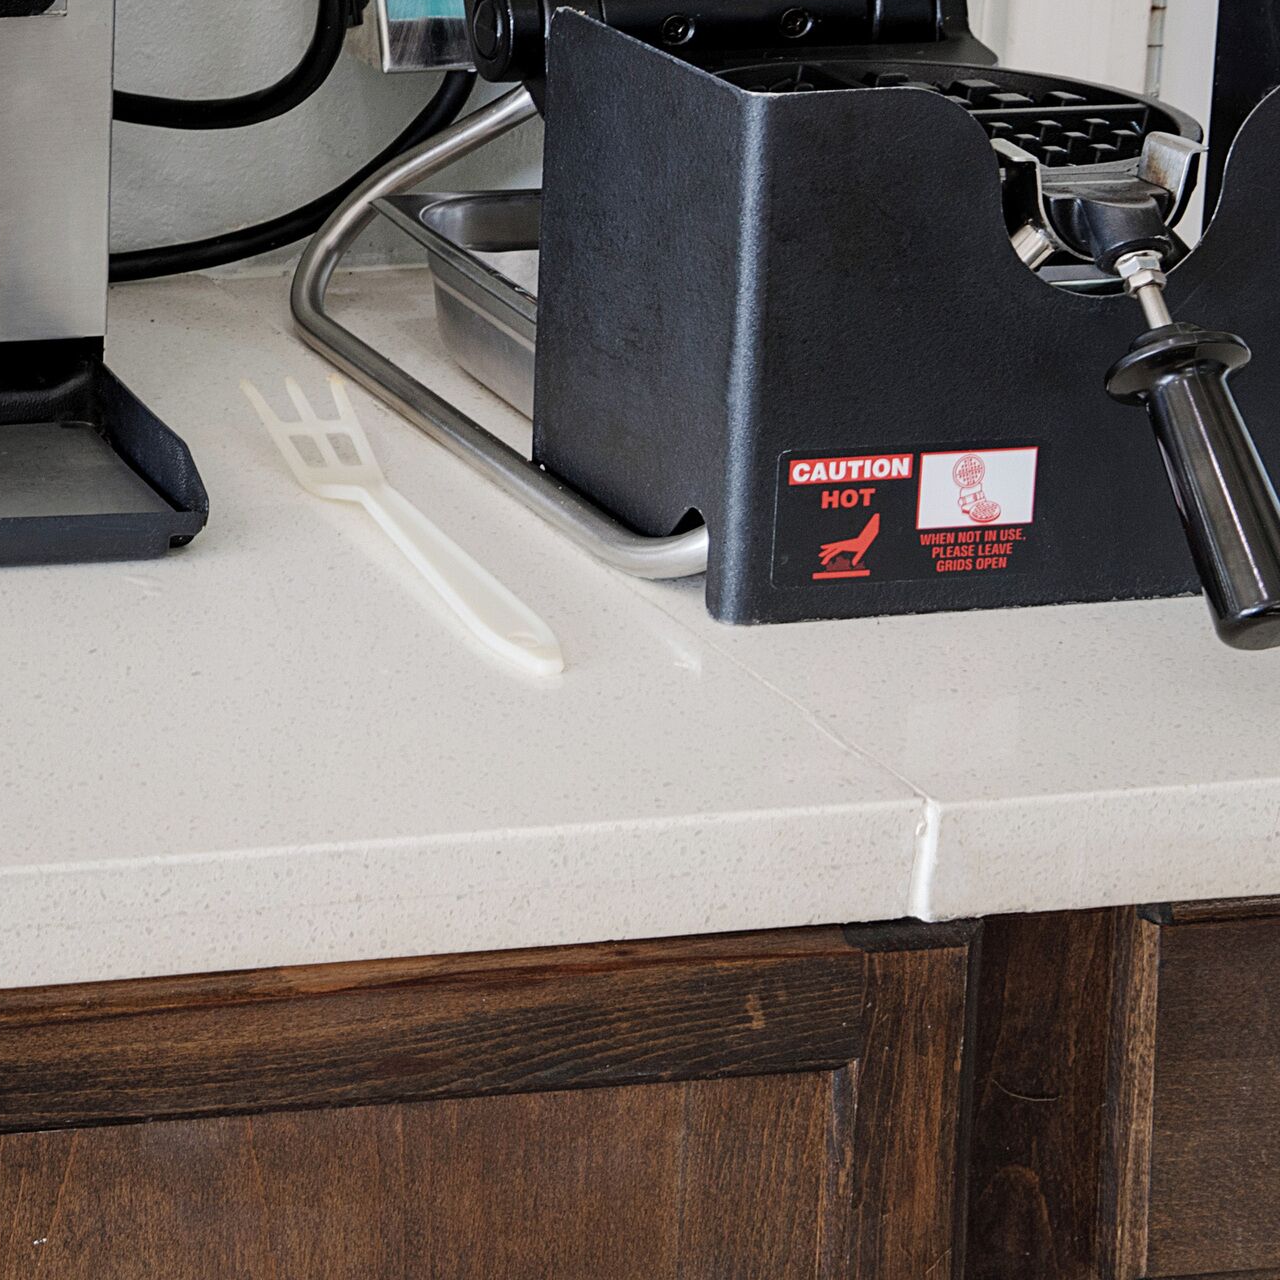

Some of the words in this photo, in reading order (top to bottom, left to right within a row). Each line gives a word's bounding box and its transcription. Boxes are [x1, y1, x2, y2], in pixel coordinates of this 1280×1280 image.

[792, 457, 910, 483] CAUTION
[821, 488, 876, 509] HOT
[920, 532, 954, 546] WHEN
[957, 531, 981, 544] NOT
[984, 530, 997, 542] IN
[932, 545, 975, 558] PLEASE
[978, 543, 1013, 556] LEAVE
[936, 559, 973, 572] GRIDS
[976, 557, 1007, 570] OPEN
